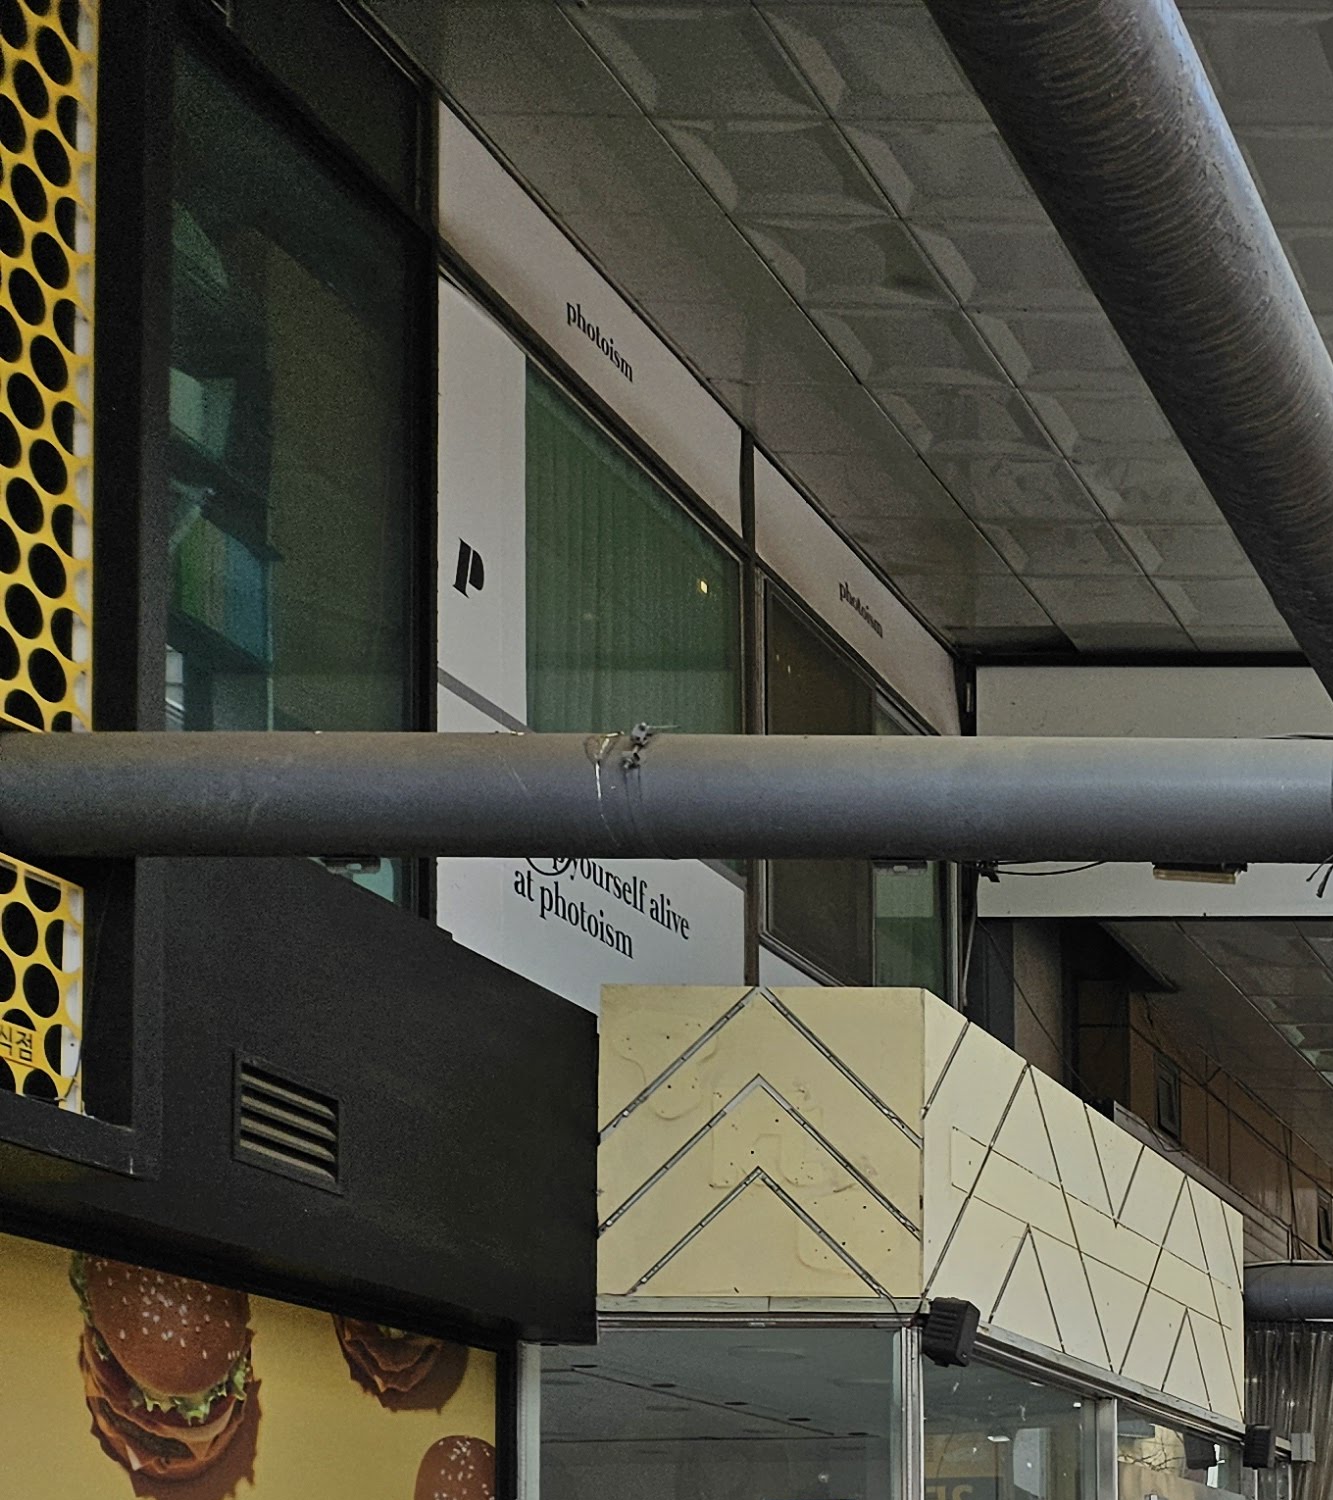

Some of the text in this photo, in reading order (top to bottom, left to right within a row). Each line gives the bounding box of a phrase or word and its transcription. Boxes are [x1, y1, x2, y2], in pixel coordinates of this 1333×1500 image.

[566, 302, 633, 383] photoism
[838, 581, 883, 638] photoism
[513, 869, 634, 960] at photoism
[569, 858, 691, 940] yourself alive
